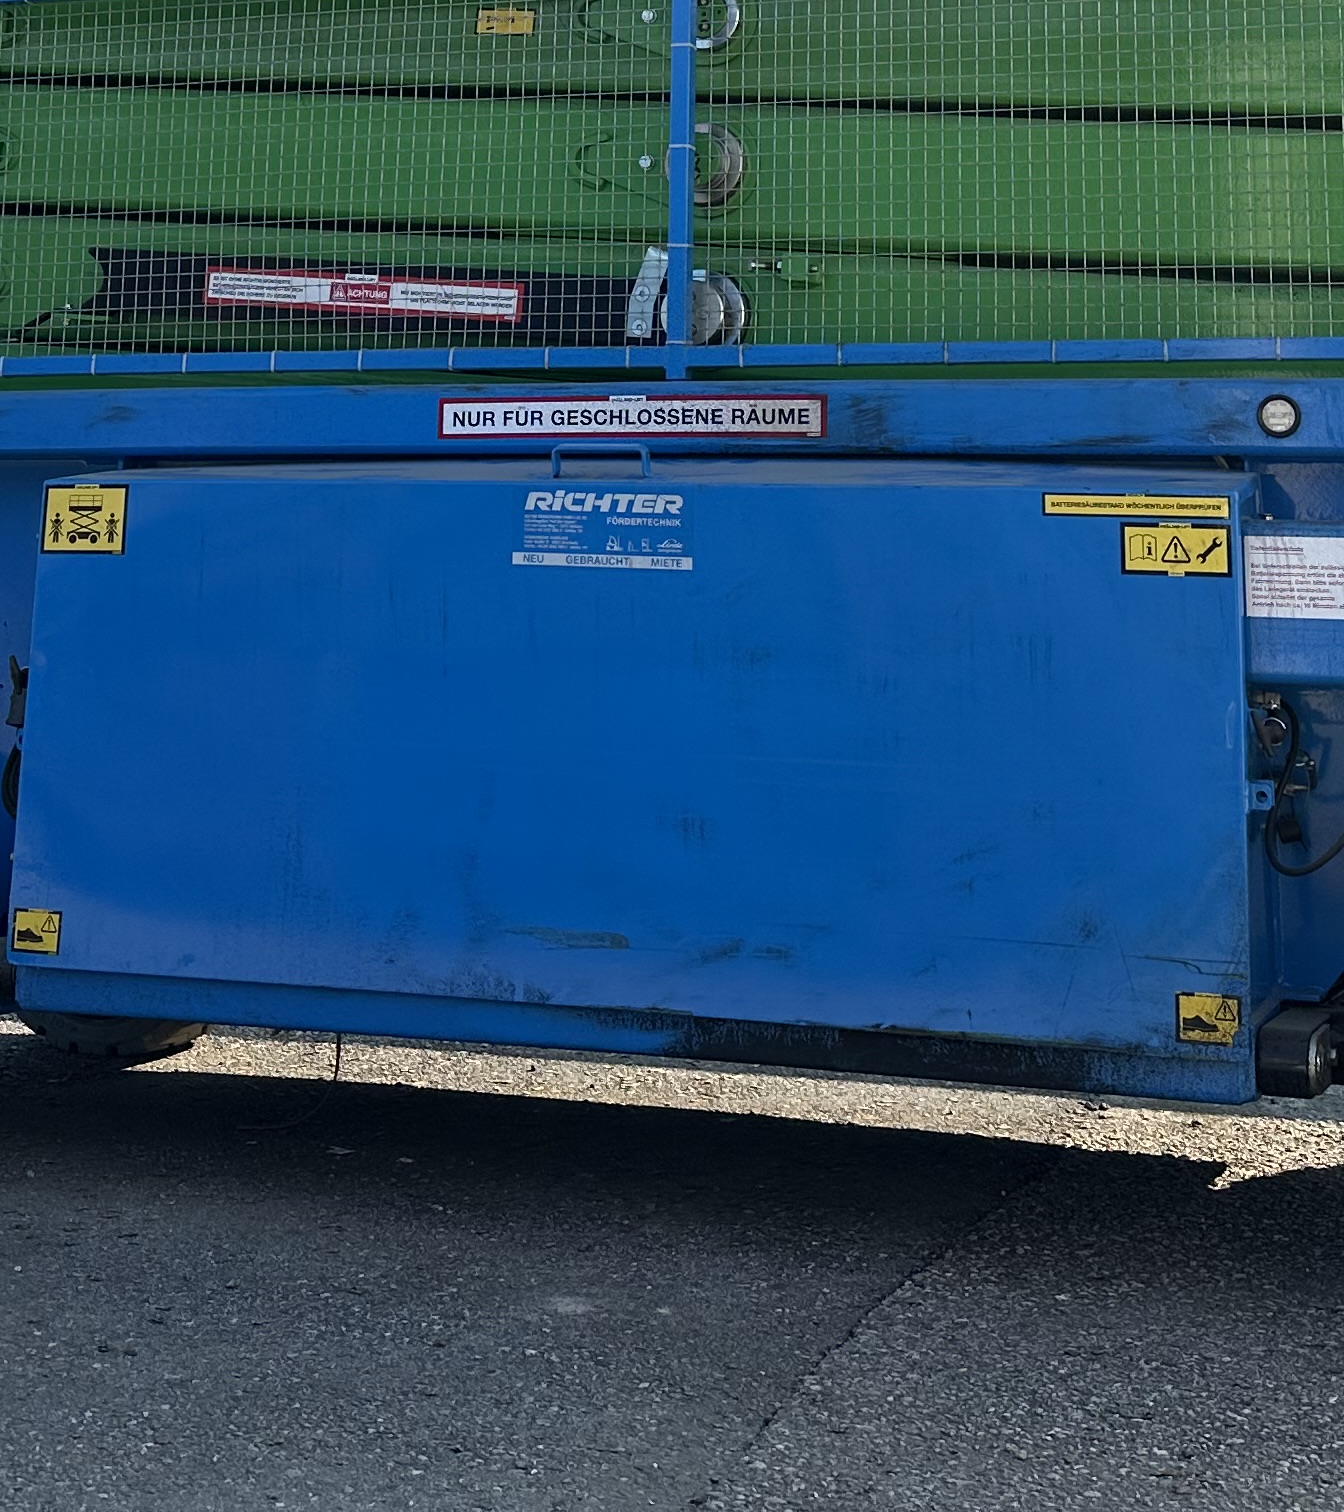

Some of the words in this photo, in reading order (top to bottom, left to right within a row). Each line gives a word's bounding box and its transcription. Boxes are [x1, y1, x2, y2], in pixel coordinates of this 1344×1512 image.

[347, 288, 388, 299] ACHTUNG
[452, 410, 496, 428] NUR
[503, 405, 544, 427] FÜR
[550, 407, 725, 427] GESCHLOSSENE
[731, 404, 811, 425] RÄUME
[606, 516, 682, 527] FÖRDERTECHNIK
[522, 554, 545, 564] NEU
[565, 555, 630, 567] GEBRAUCHT
[650, 558, 683, 568] MIETE
